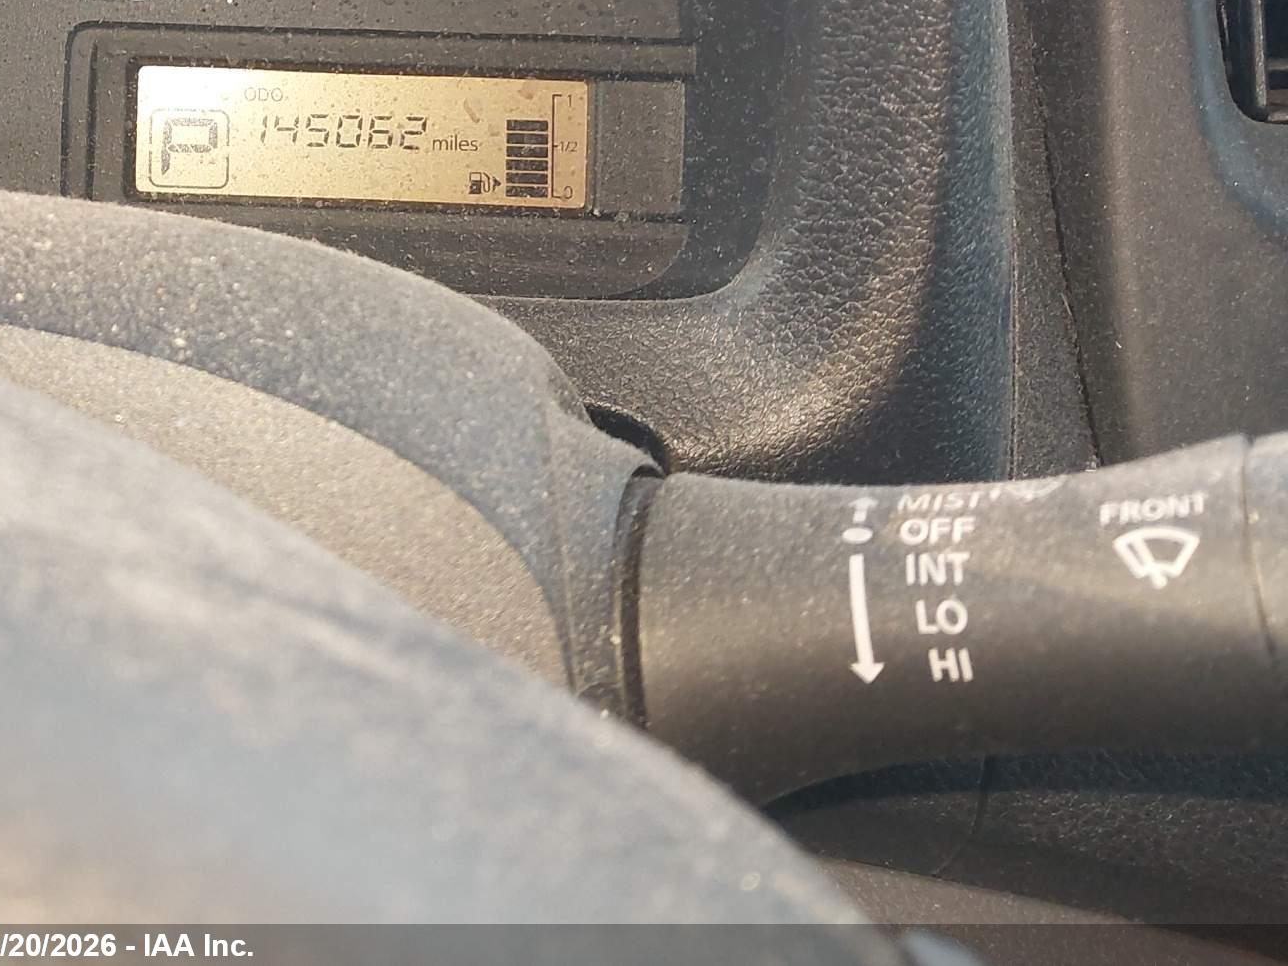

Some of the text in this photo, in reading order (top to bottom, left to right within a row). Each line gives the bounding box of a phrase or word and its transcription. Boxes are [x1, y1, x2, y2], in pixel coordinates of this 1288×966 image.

[244, 87, 284, 102] ODO
[567, 94, 572, 107] 1
[161, 117, 218, 175] P
[261, 113, 479, 153] 145062 miles
[558, 141, 578, 153] 1/2
[897, 491, 985, 512] MIST
[1099, 491, 1209, 526] FRONT
[899, 516, 975, 546] OFF
[905, 552, 970, 586] INT
[915, 599, 968, 635] LO
[928, 648, 974, 683] HI
